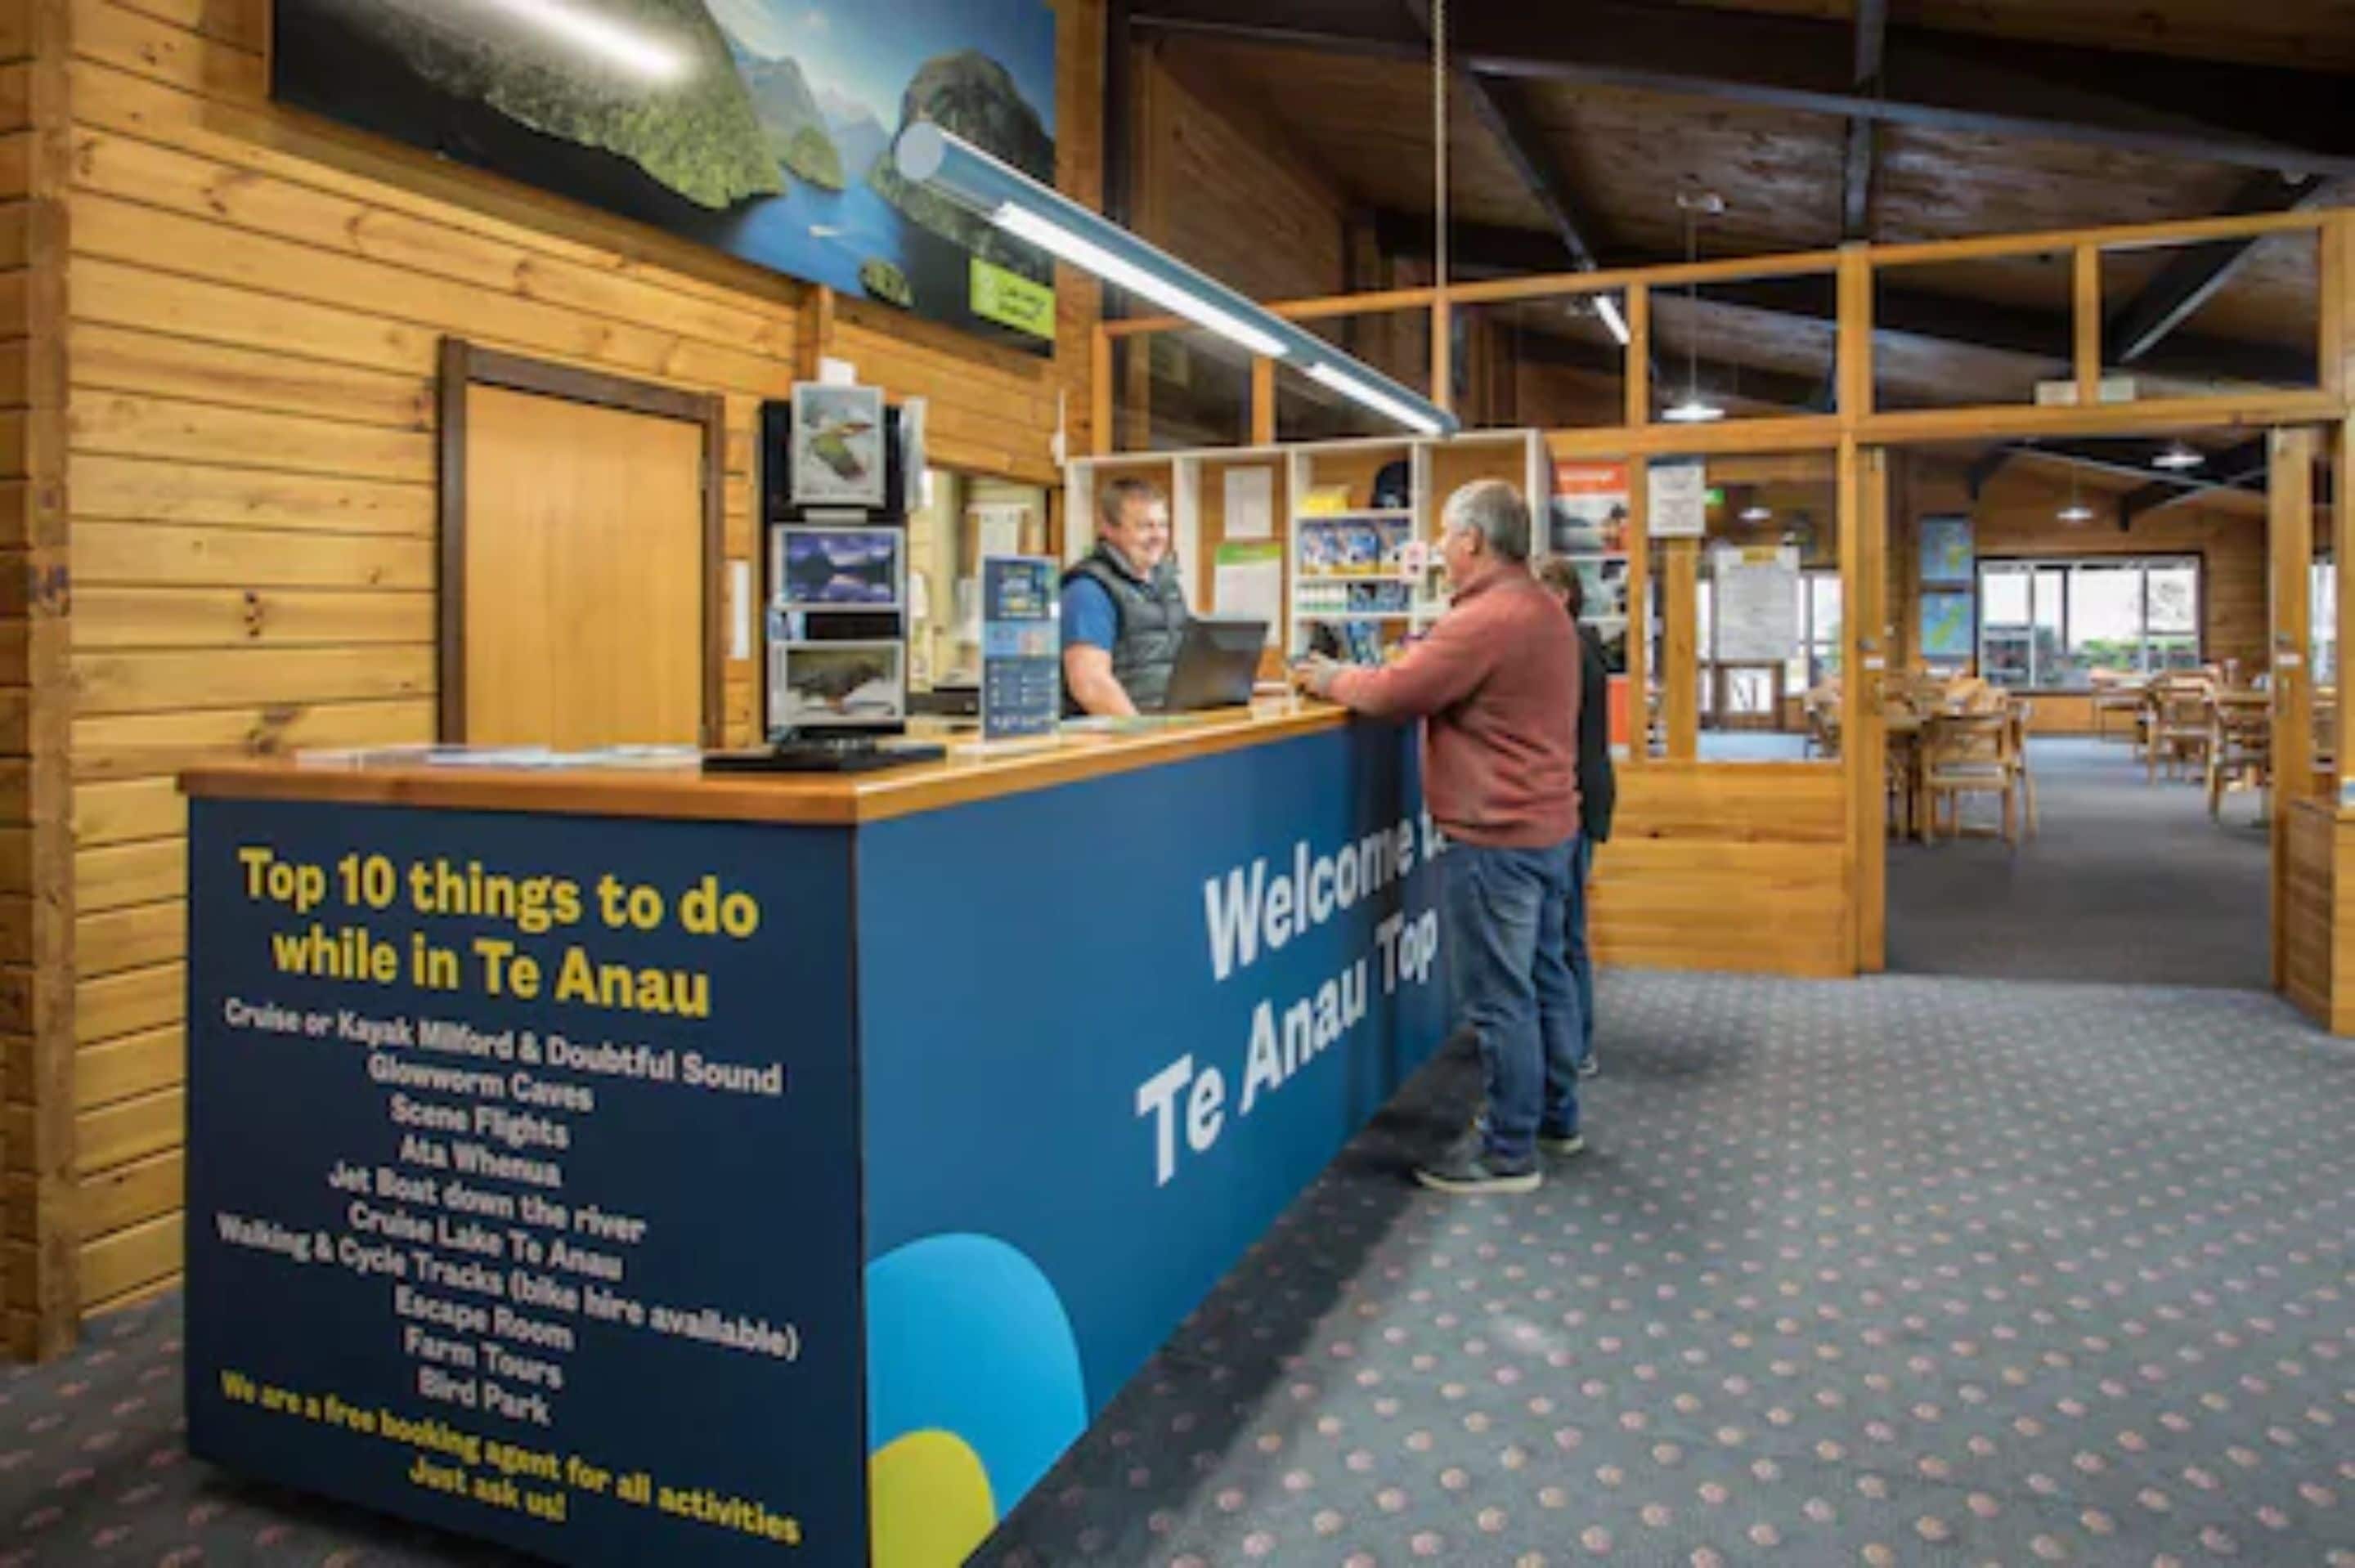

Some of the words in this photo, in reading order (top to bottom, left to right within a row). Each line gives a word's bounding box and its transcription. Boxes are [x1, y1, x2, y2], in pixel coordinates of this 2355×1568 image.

[240, 847, 325, 912] Top
[339, 854, 395, 908] 10
[409, 860, 581, 934] things
[597, 872, 663, 929] to
[680, 876, 760, 939] do
[1204, 818, 1415, 983] Welcome
[273, 927, 397, 982] while
[412, 933, 459, 989] in
[473, 940, 540, 999] Te
[555, 946, 711, 1019] Anau
[224, 997, 298, 1033] Cruise
[303, 1011, 332, 1037] or
[338, 1008, 414, 1048] Kayak
[418, 1019, 514, 1060] Milford
[518, 1029, 541, 1064] &
[546, 1034, 675, 1082] Doubtful
[682, 1052, 783, 1095] Sound
[368, 1051, 505, 1098] Glowworm
[511, 1072, 594, 1112] Caves
[1135, 1053, 1225, 1188] Te
[1239, 959, 1367, 1117] Anau
[1375, 908, 1438, 995] Top
[389, 1091, 469, 1131] Scene
[474, 1105, 569, 1149] Flights
[328, 1161, 372, 1193] Jet
[376, 1167, 437, 1207] Boat
[442, 1180, 514, 1218] down
[519, 1194, 567, 1230] the
[574, 1204, 647, 1243] river
[451, 1140, 562, 1187] Whenua
[348, 1200, 433, 1243] Cruise
[437, 1217, 503, 1257] Lake
[508, 1229, 543, 1264] Te
[548, 1238, 623, 1281] Anau
[216, 1212, 311, 1263] Walking
[315, 1230, 334, 1263] &
[339, 1236, 406, 1275] Cycle
[412, 1250, 504, 1296] Tracks
[508, 1268, 578, 1312] (bike
[583, 1284, 644, 1326] hire
[650, 1306, 800, 1363] available)
[395, 1284, 488, 1333] Escape
[494, 1306, 574, 1351] Room
[404, 1325, 476, 1368] Farm
[482, 1342, 564, 1390] Tours
[418, 1364, 477, 1407] Bird
[484, 1382, 552, 1427] Park
[221, 1369, 255, 1404] We
[261, 1384, 302, 1414] are
[304, 1397, 321, 1419] a
[325, 1392, 375, 1432] free
[380, 1408, 481, 1465] booking
[484, 1440, 561, 1481] agent
[566, 1453, 611, 1494] for
[617, 1472, 651, 1505] all
[658, 1485, 803, 1546] activities
[410, 1456, 467, 1494] Just
[474, 1476, 518, 1511] ask
